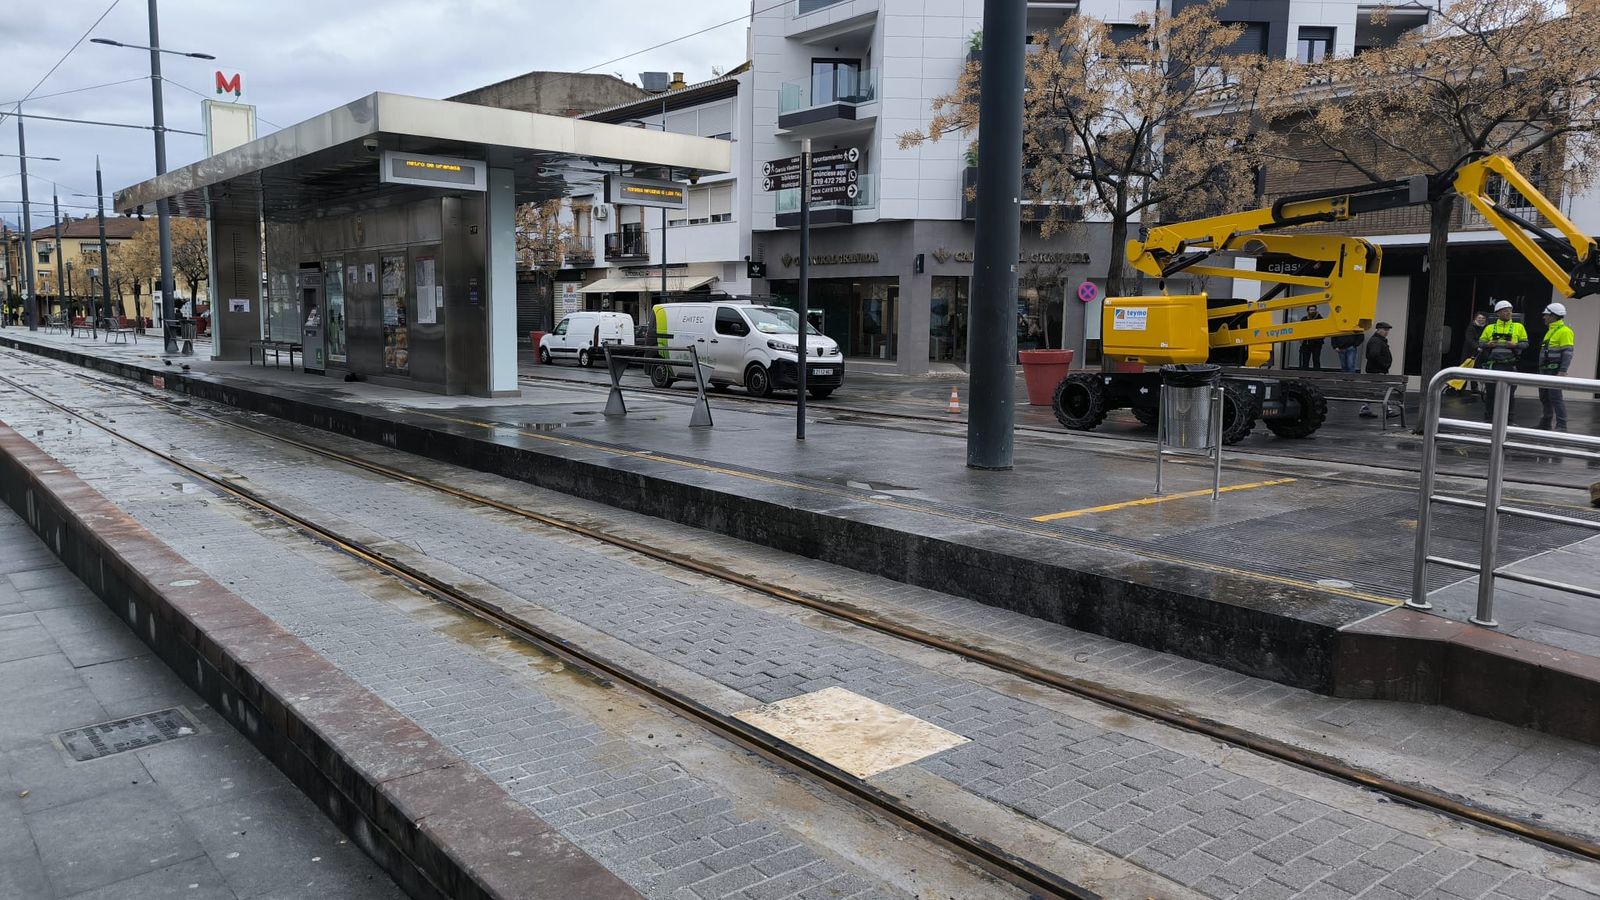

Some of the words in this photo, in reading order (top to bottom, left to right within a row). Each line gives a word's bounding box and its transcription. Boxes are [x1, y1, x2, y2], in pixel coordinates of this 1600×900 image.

[216, 71, 241, 96] M
[1268, 261, 1301, 273] cajas
[1266, 327, 1294, 338] teymo
